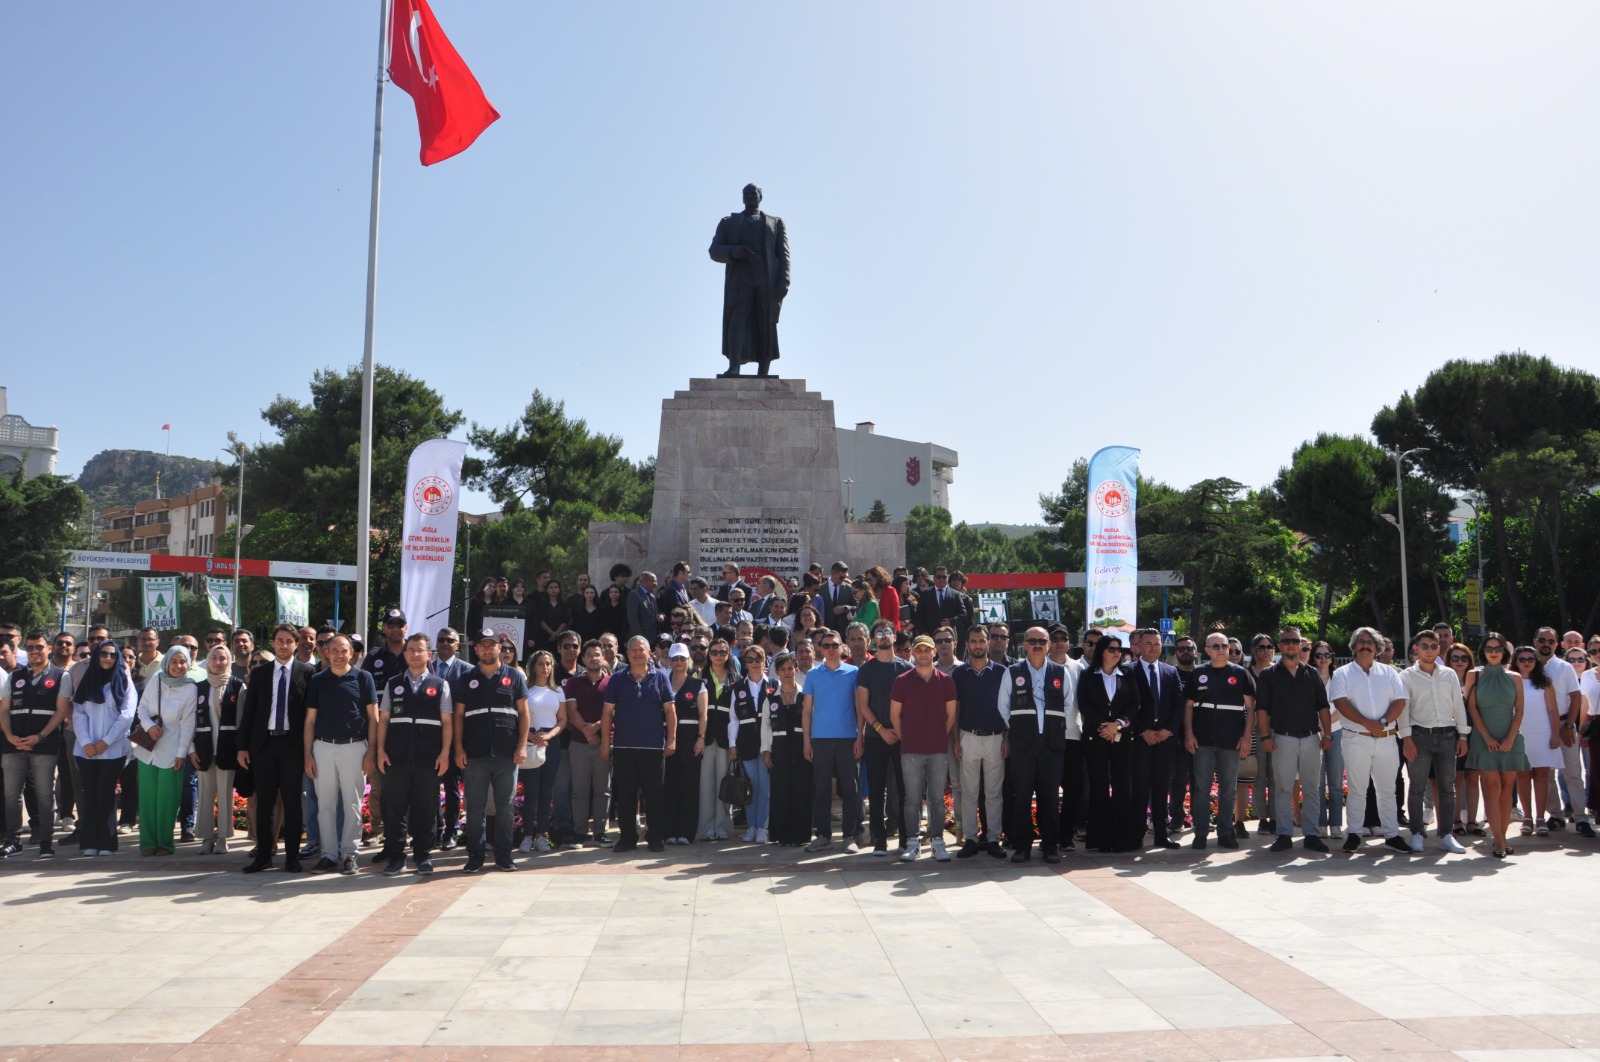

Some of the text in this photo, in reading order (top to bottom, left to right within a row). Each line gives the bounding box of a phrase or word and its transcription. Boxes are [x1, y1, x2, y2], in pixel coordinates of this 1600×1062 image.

[78, 555, 115, 563] BÜYÜKŞEHİR
[117, 556, 149, 564] BELEDİYESİ
[148, 619, 176, 627] POLGÜN
